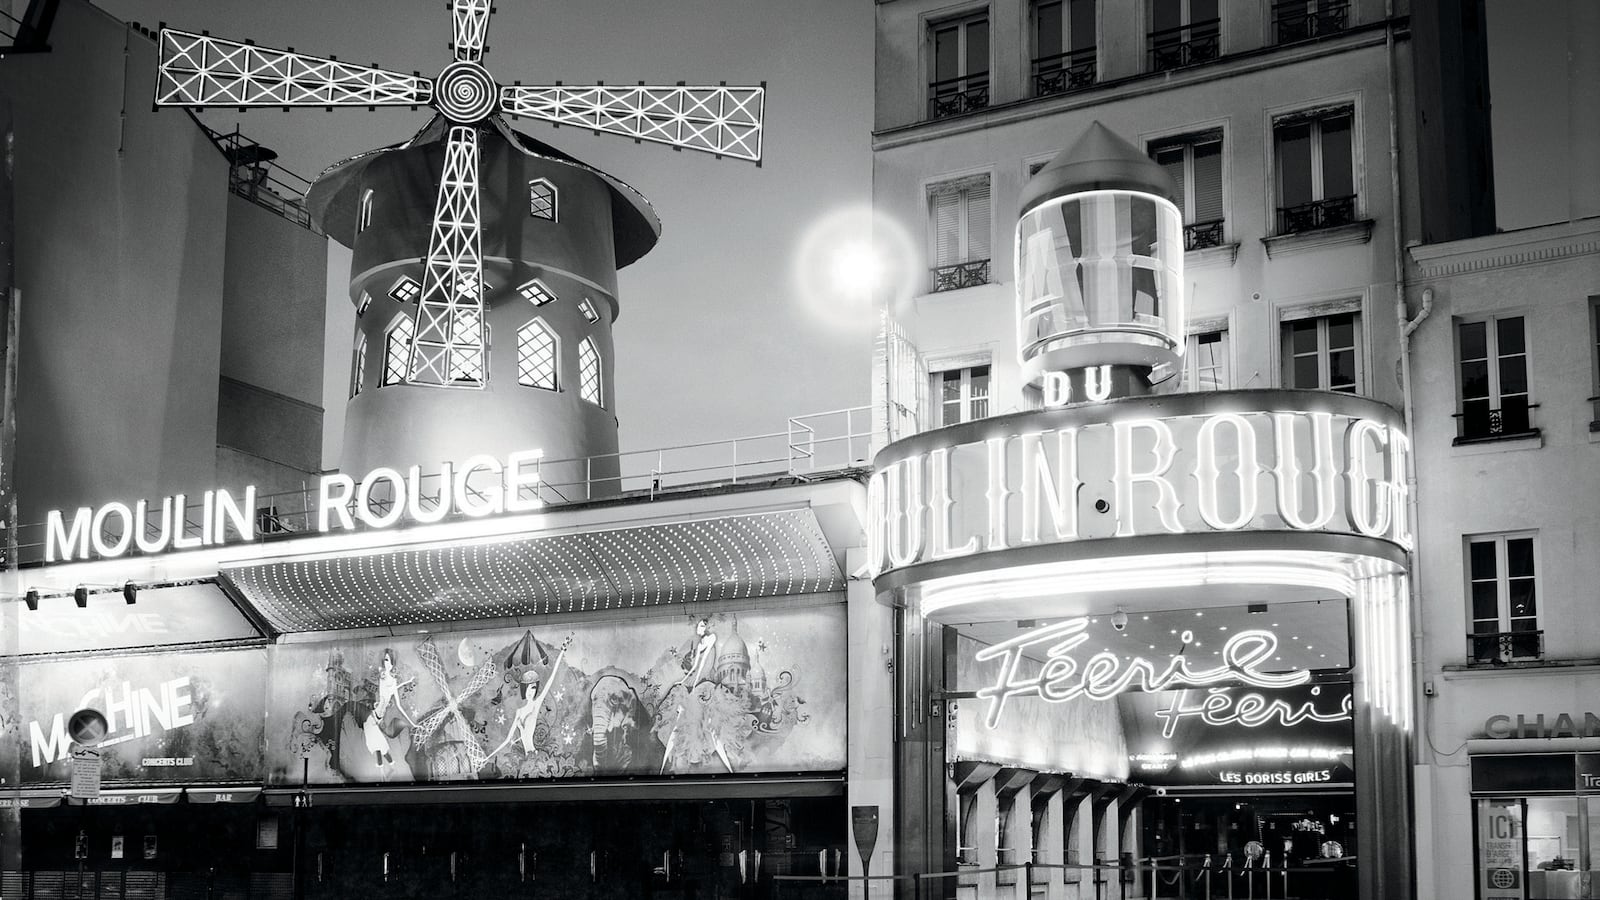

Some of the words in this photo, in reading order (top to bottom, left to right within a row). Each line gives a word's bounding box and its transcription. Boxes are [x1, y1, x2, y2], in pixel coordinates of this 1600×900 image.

[1042, 364, 1113, 407] DU
[45, 485, 256, 562] MOULIN
[318, 449, 543, 531] ROUGE
[866, 428, 1081, 577] OULIN
[975, 616, 1310, 730] Féerie
[215, 794, 233, 802] BAR
[1220, 771, 1242, 783] LES
[1245, 773, 1292, 784] DORISS
[1293, 770, 1331, 784] GIRLS
